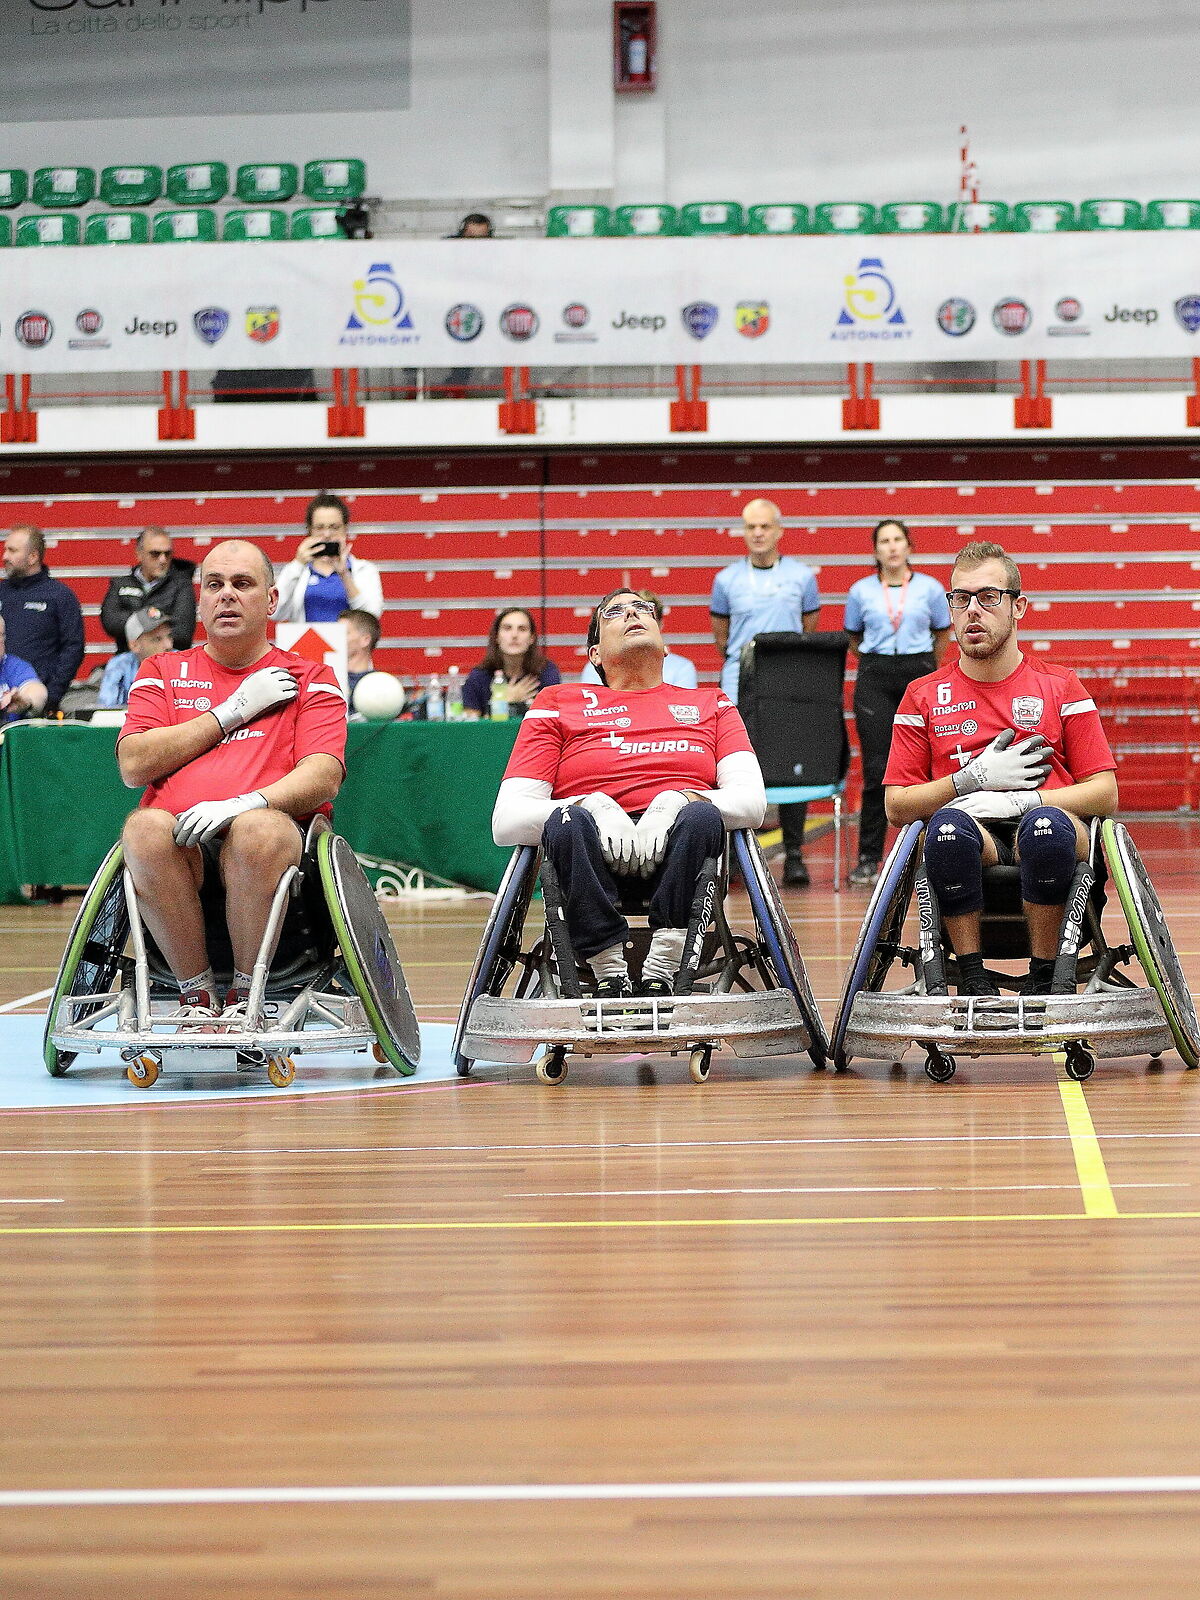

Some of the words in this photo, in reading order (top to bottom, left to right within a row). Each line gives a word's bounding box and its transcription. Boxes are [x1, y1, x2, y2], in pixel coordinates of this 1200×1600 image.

[31, 16, 60, 36] La
[67, 13, 119, 35] città
[125, 13, 182, 33] dello
[188, 11, 251, 31] sport
[611, 310, 666, 333] Jeep
[1104, 304, 1158, 327] Jeep
[124, 316, 178, 338] Jeep
[829, 329, 913, 341] AUTONOMY
[338, 333, 421, 346] AUTONOMY
[180, 661, 188, 678] 1
[170, 679, 213, 690] macron
[581, 689, 599, 709] 5
[937, 682, 952, 705] 6
[582, 705, 628, 717] macron
[932, 700, 977, 716] macron
[934, 723, 961, 734] Rotary
[618, 740, 689, 754] SICURO
[689, 745, 705, 754] SRL
